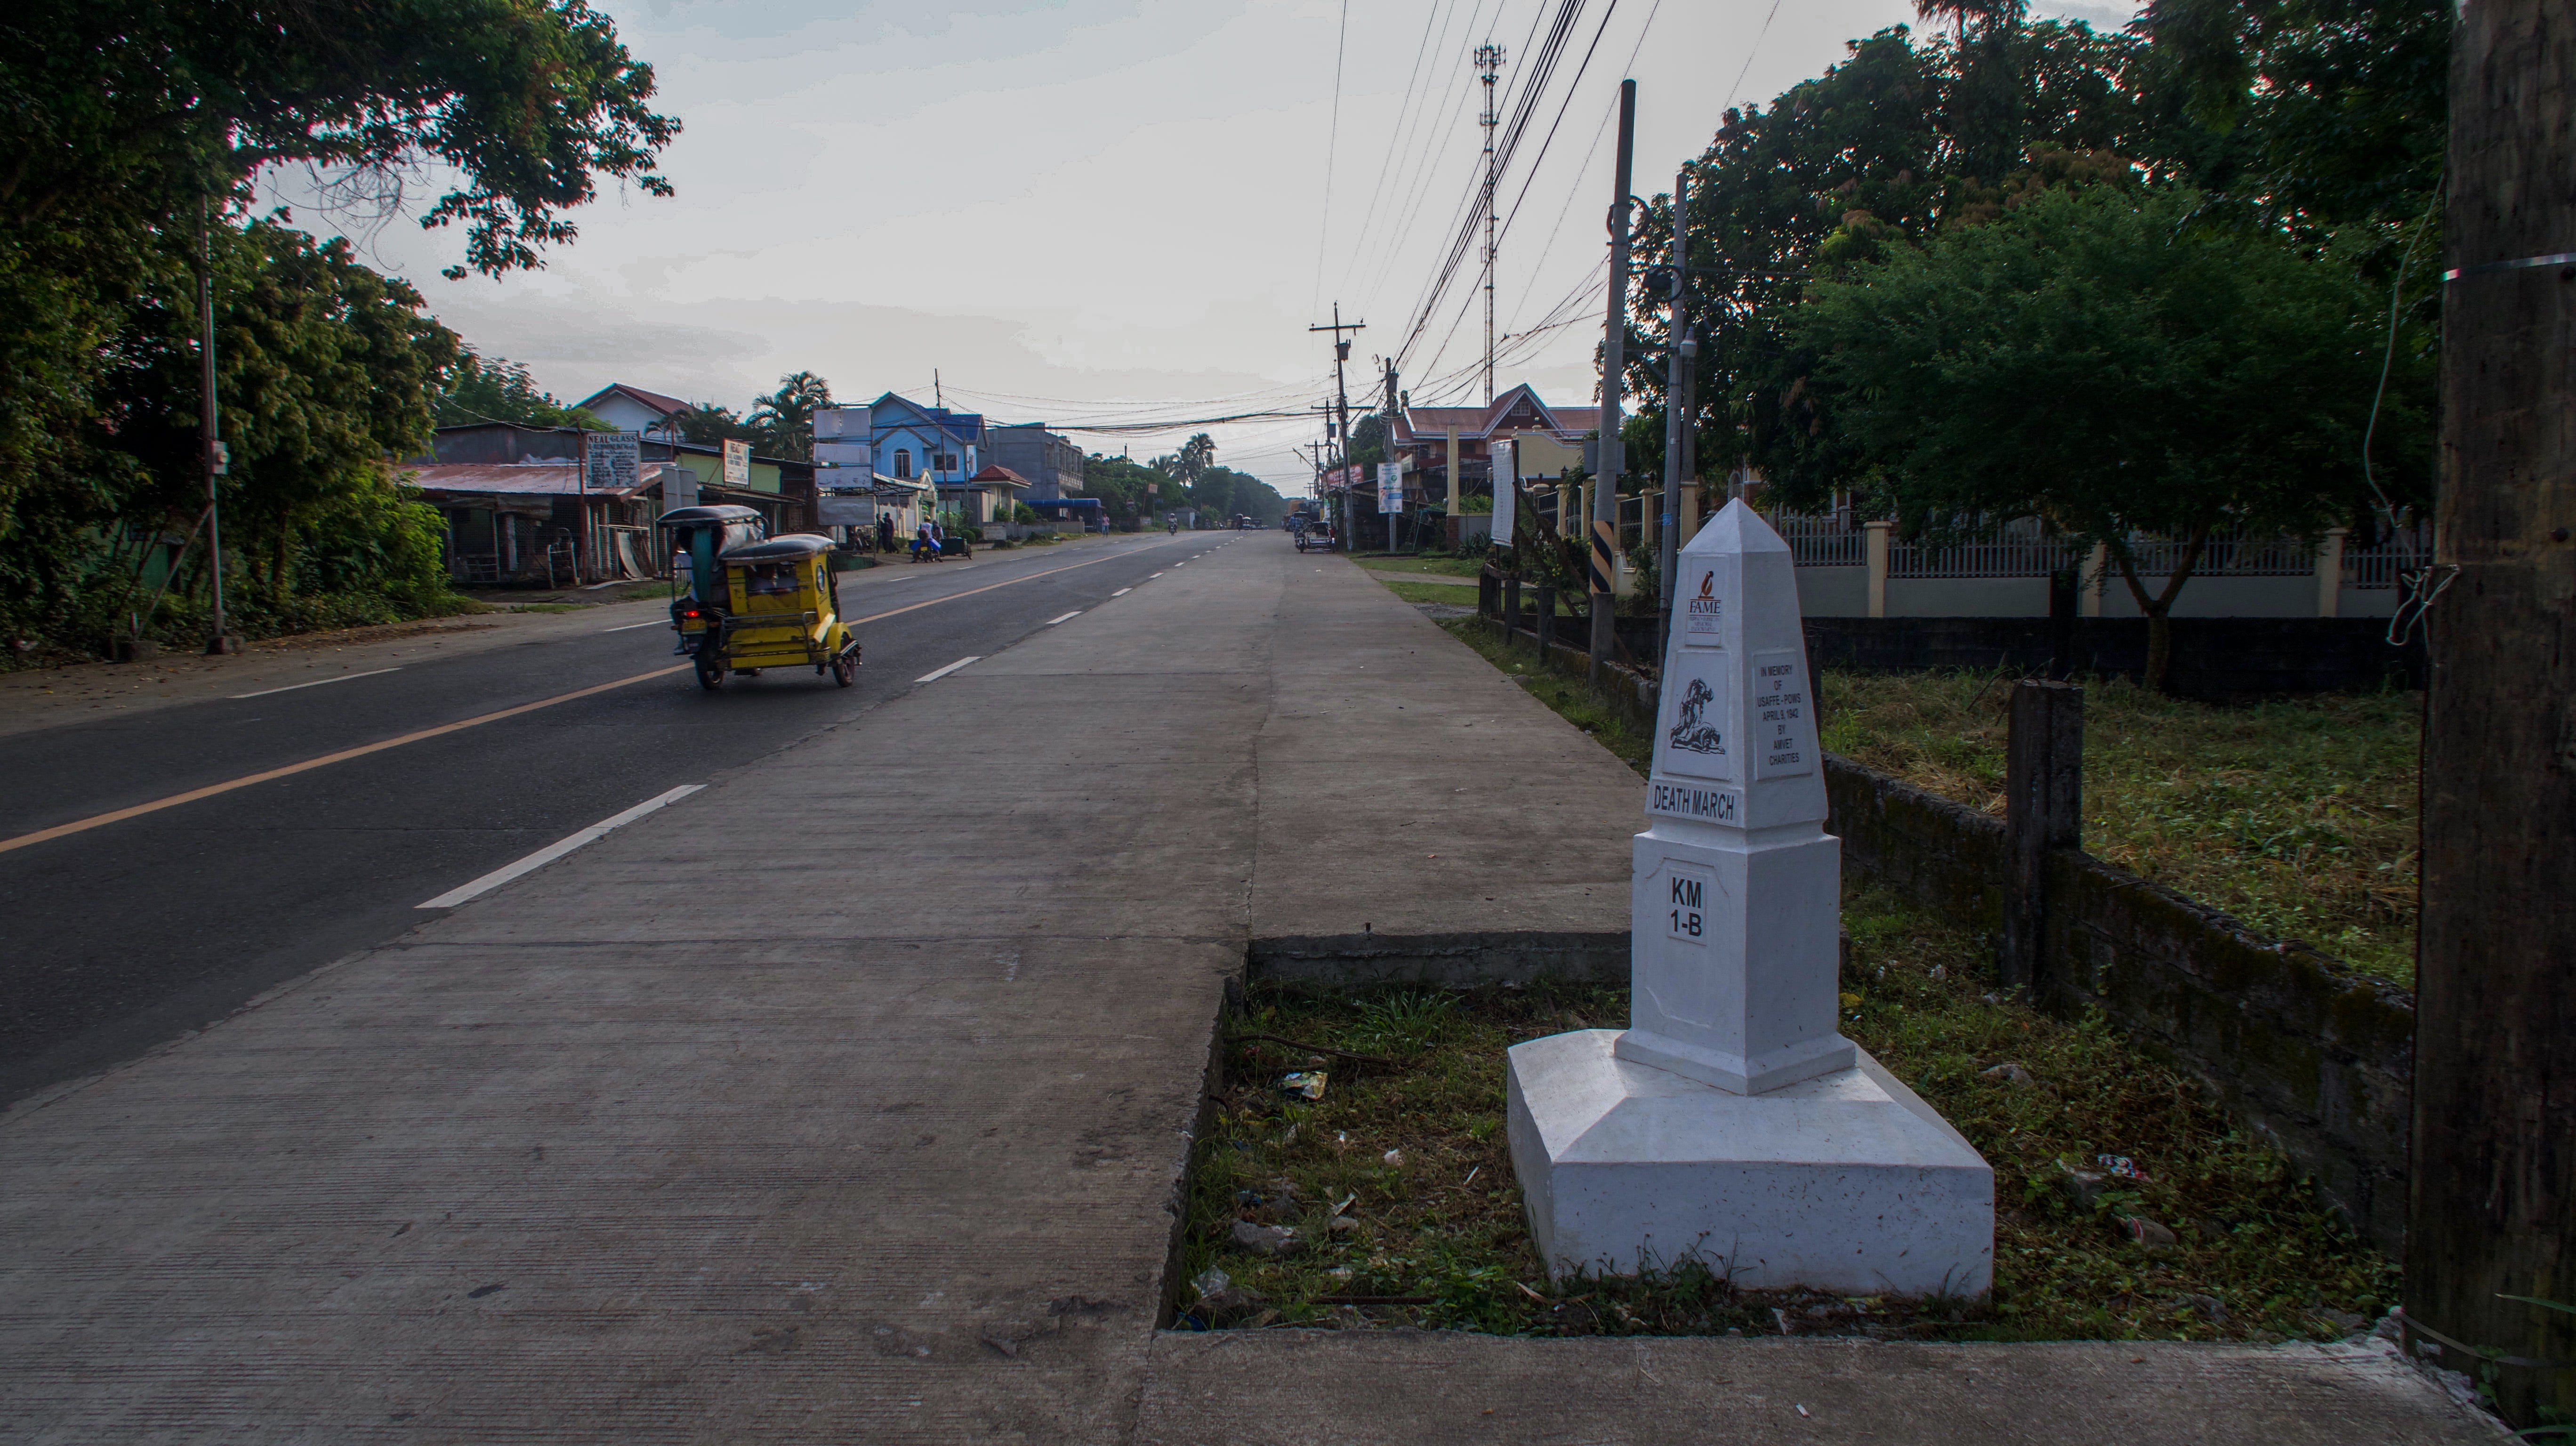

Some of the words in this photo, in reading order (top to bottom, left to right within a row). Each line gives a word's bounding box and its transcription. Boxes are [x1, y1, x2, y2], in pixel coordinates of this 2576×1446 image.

[588, 435, 610, 443] NEAL
[1689, 601, 1721, 613] FAME
[1761, 667, 1766, 677] IN
[1768, 664, 1793, 676] MEMORY
[1774, 680, 1782, 691] OF
[1757, 695, 1780, 707] USAFFE
[1784, 693, 1801, 704] POWS
[1763, 710, 1779, 722] APRIL
[1780, 710, 1786, 721] 9,
[1786, 708, 1799, 719] 1942
[1778, 724, 1786, 735] BY
[1773, 738, 1793, 750] AMVET
[1769, 752, 1799, 766] CHARITIES
[1654, 785, 1690, 813] DEATH
[1692, 790, 1734, 820] MARCH
[1672, 877, 1701, 908] KM
[1671, 909, 1702, 937] 1-B
